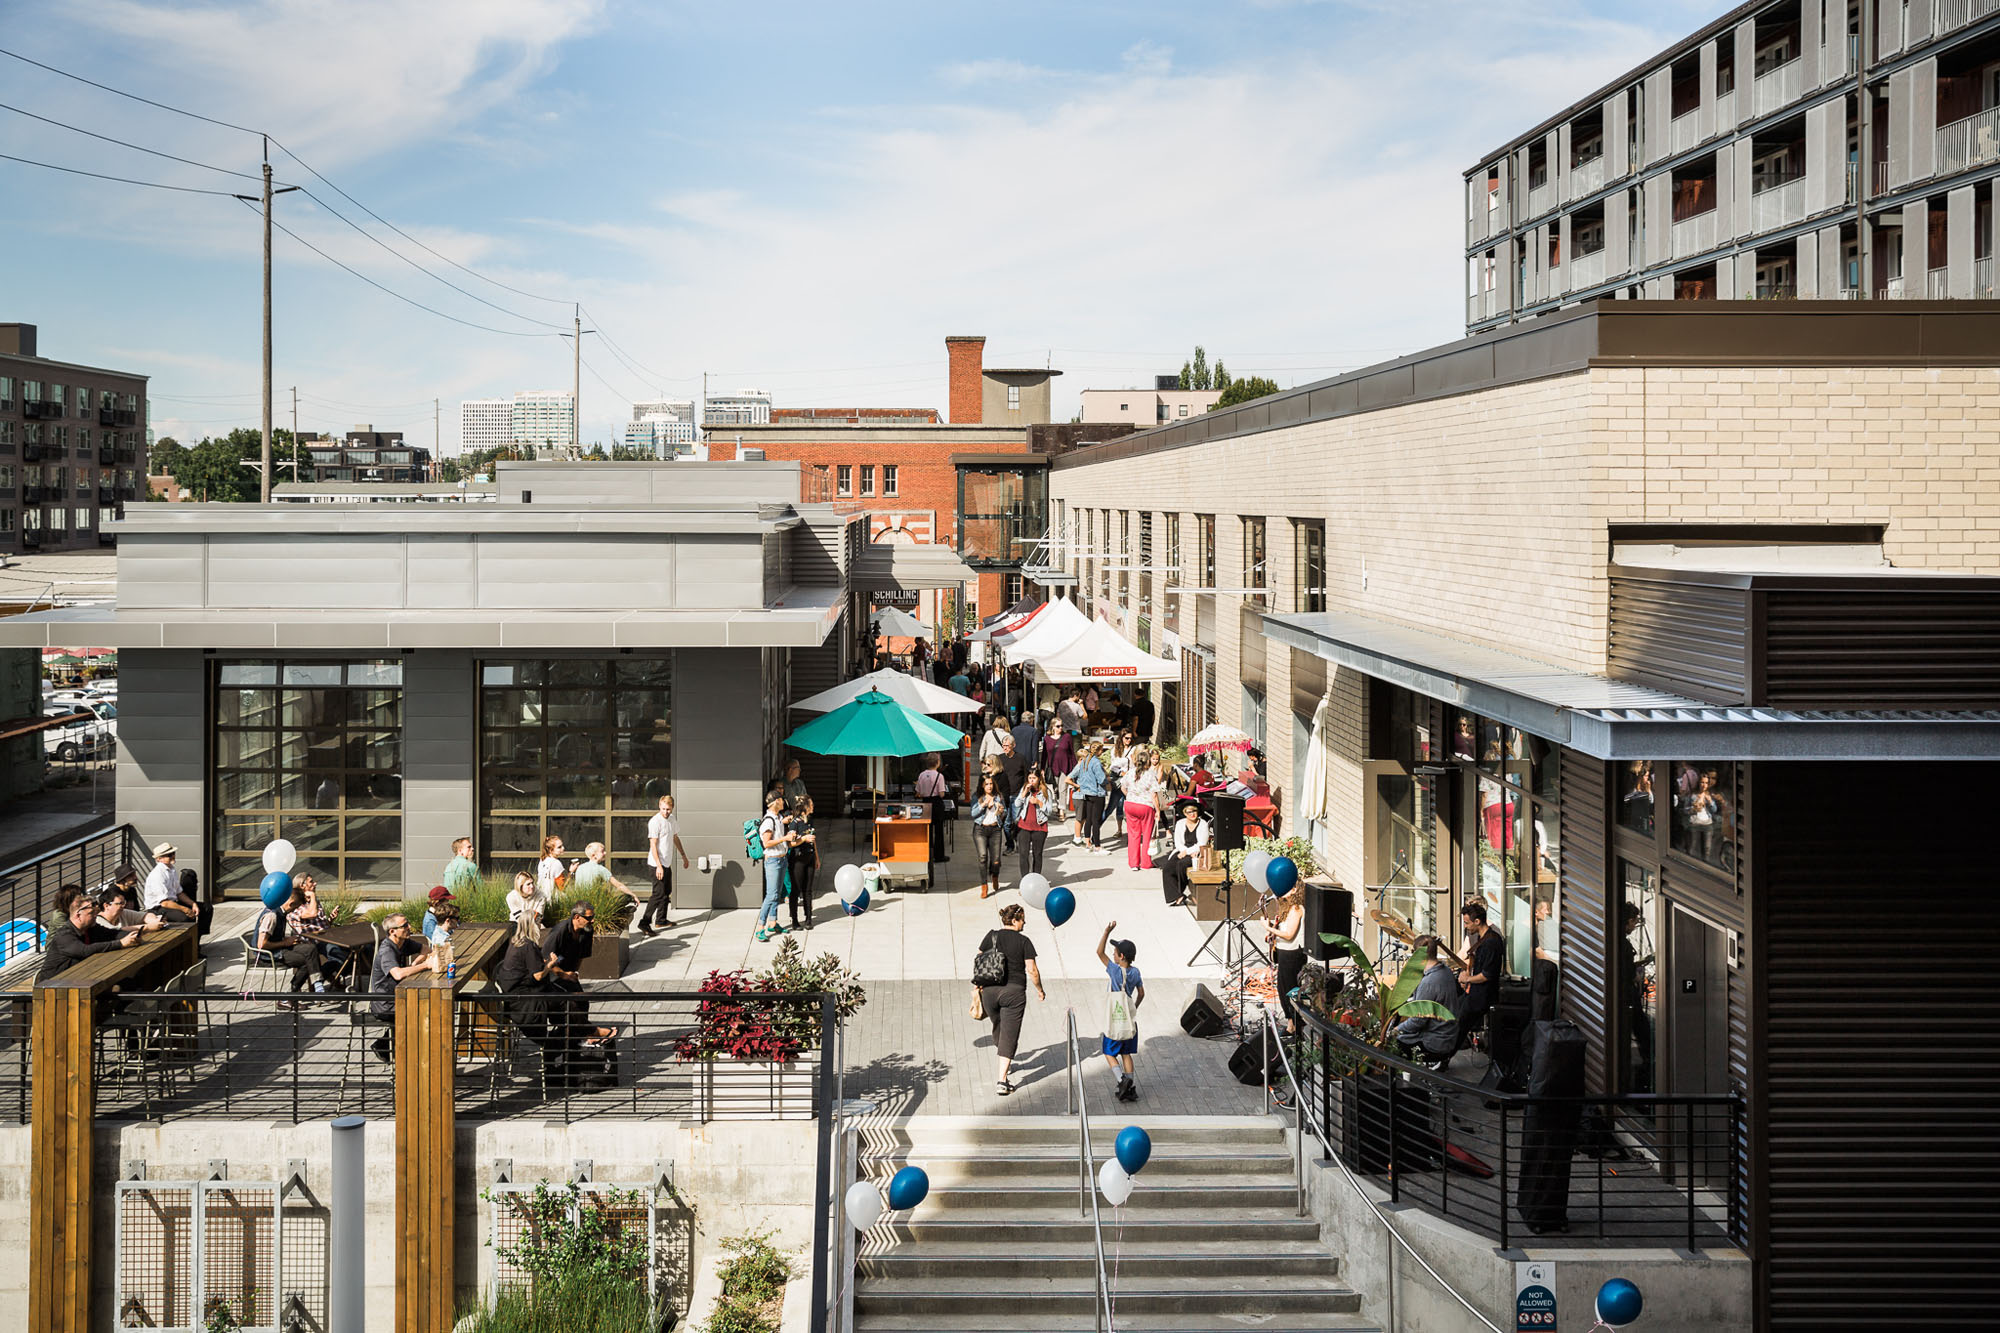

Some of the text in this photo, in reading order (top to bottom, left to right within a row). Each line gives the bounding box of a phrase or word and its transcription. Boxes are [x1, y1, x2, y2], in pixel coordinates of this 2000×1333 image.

[875, 590, 917, 600] SCHILLING
[1686, 980, 1693, 989] P
[1519, 1299, 1553, 1307] ALLOWED
